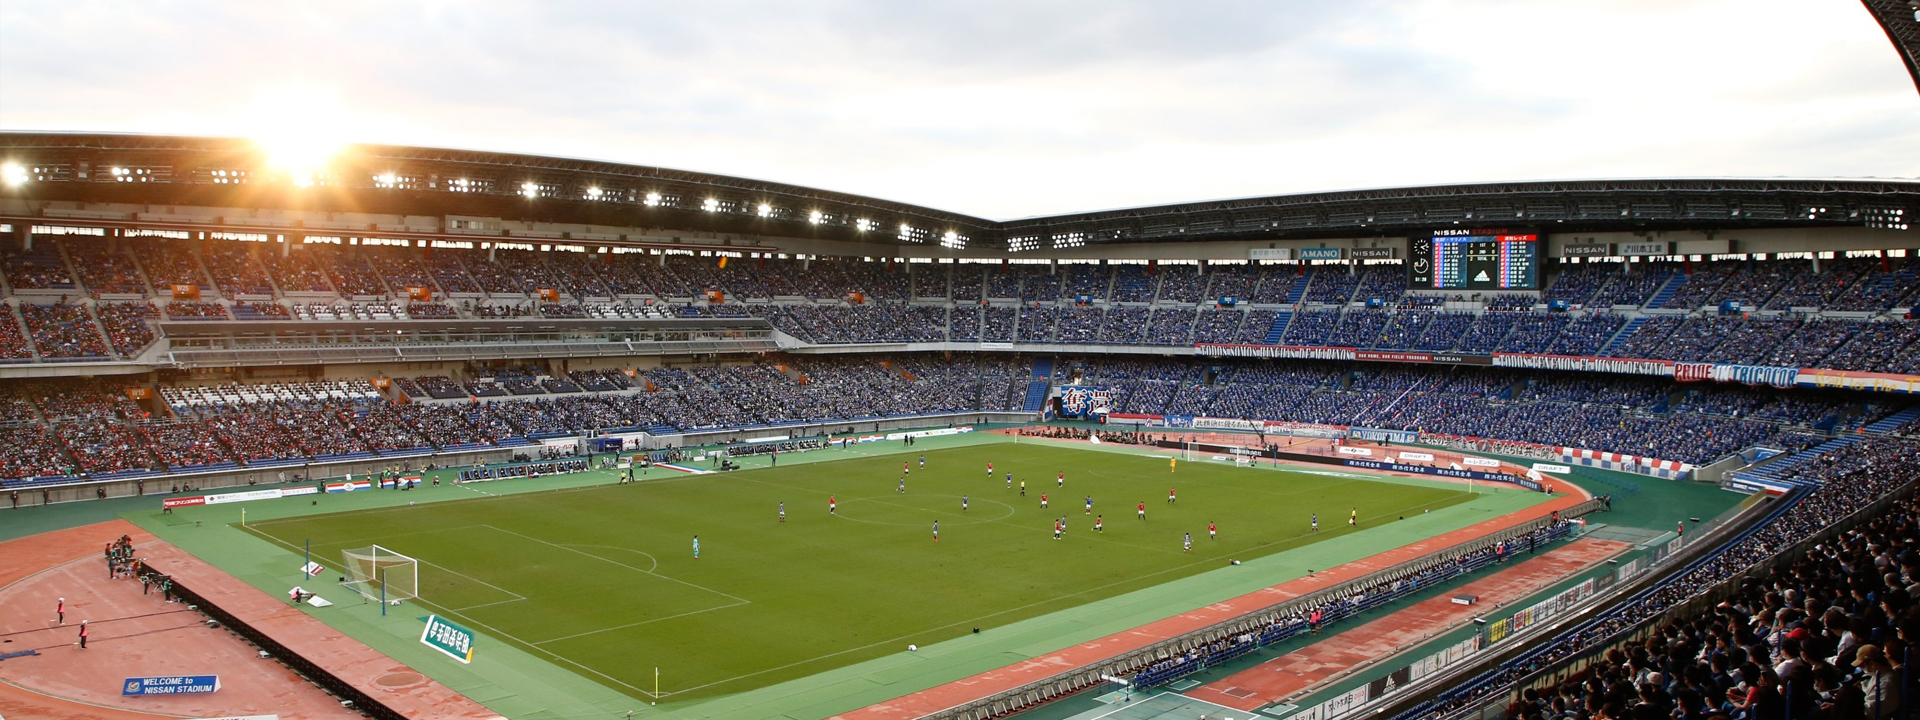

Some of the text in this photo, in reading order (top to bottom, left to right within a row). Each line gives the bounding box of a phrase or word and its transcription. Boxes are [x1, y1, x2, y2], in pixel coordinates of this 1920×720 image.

[1201, 345, 1228, 356] TODOS
[1230, 346, 1257, 357] SOMOS
[1299, 347, 1311, 359] DE
[1315, 348, 1351, 360] MARINOS
[1499, 354, 1666, 375] TODOS TENEMOS EL MISMO DESTINO
[1674, 362, 1714, 382] PRIDE
[1730, 364, 1798, 388] TRICOLOR
[1874, 377, 1897, 392] the
[1905, 378, 1920, 394] T
[1062, 388, 1113, 416] 奪還
[430, 620, 470, 654] 明治安田生命
